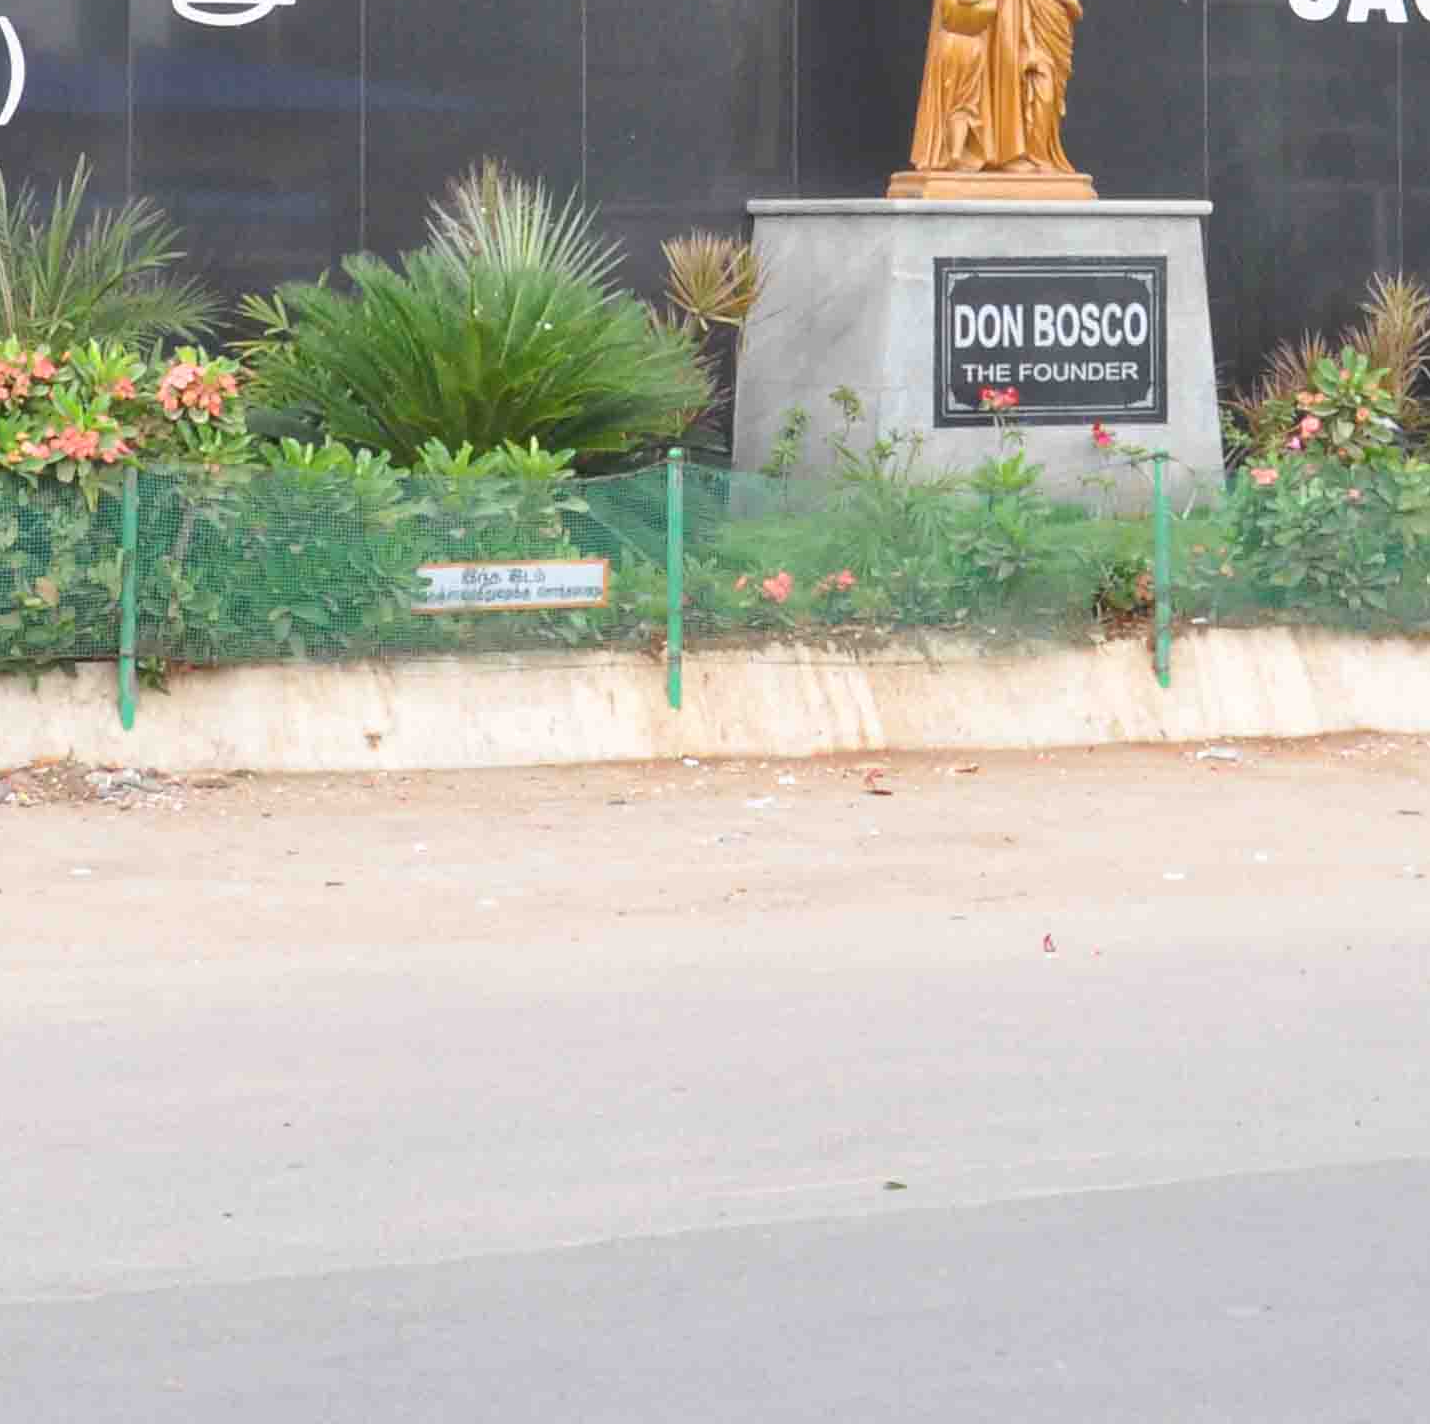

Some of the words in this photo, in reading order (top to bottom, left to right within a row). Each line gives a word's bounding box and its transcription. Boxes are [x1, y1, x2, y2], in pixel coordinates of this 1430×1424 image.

[953, 303, 1025, 349] DON
[1032, 301, 1149, 348] BOSCO
[961, 362, 1013, 384] THE
[1017, 360, 1140, 382] FOUNDER
